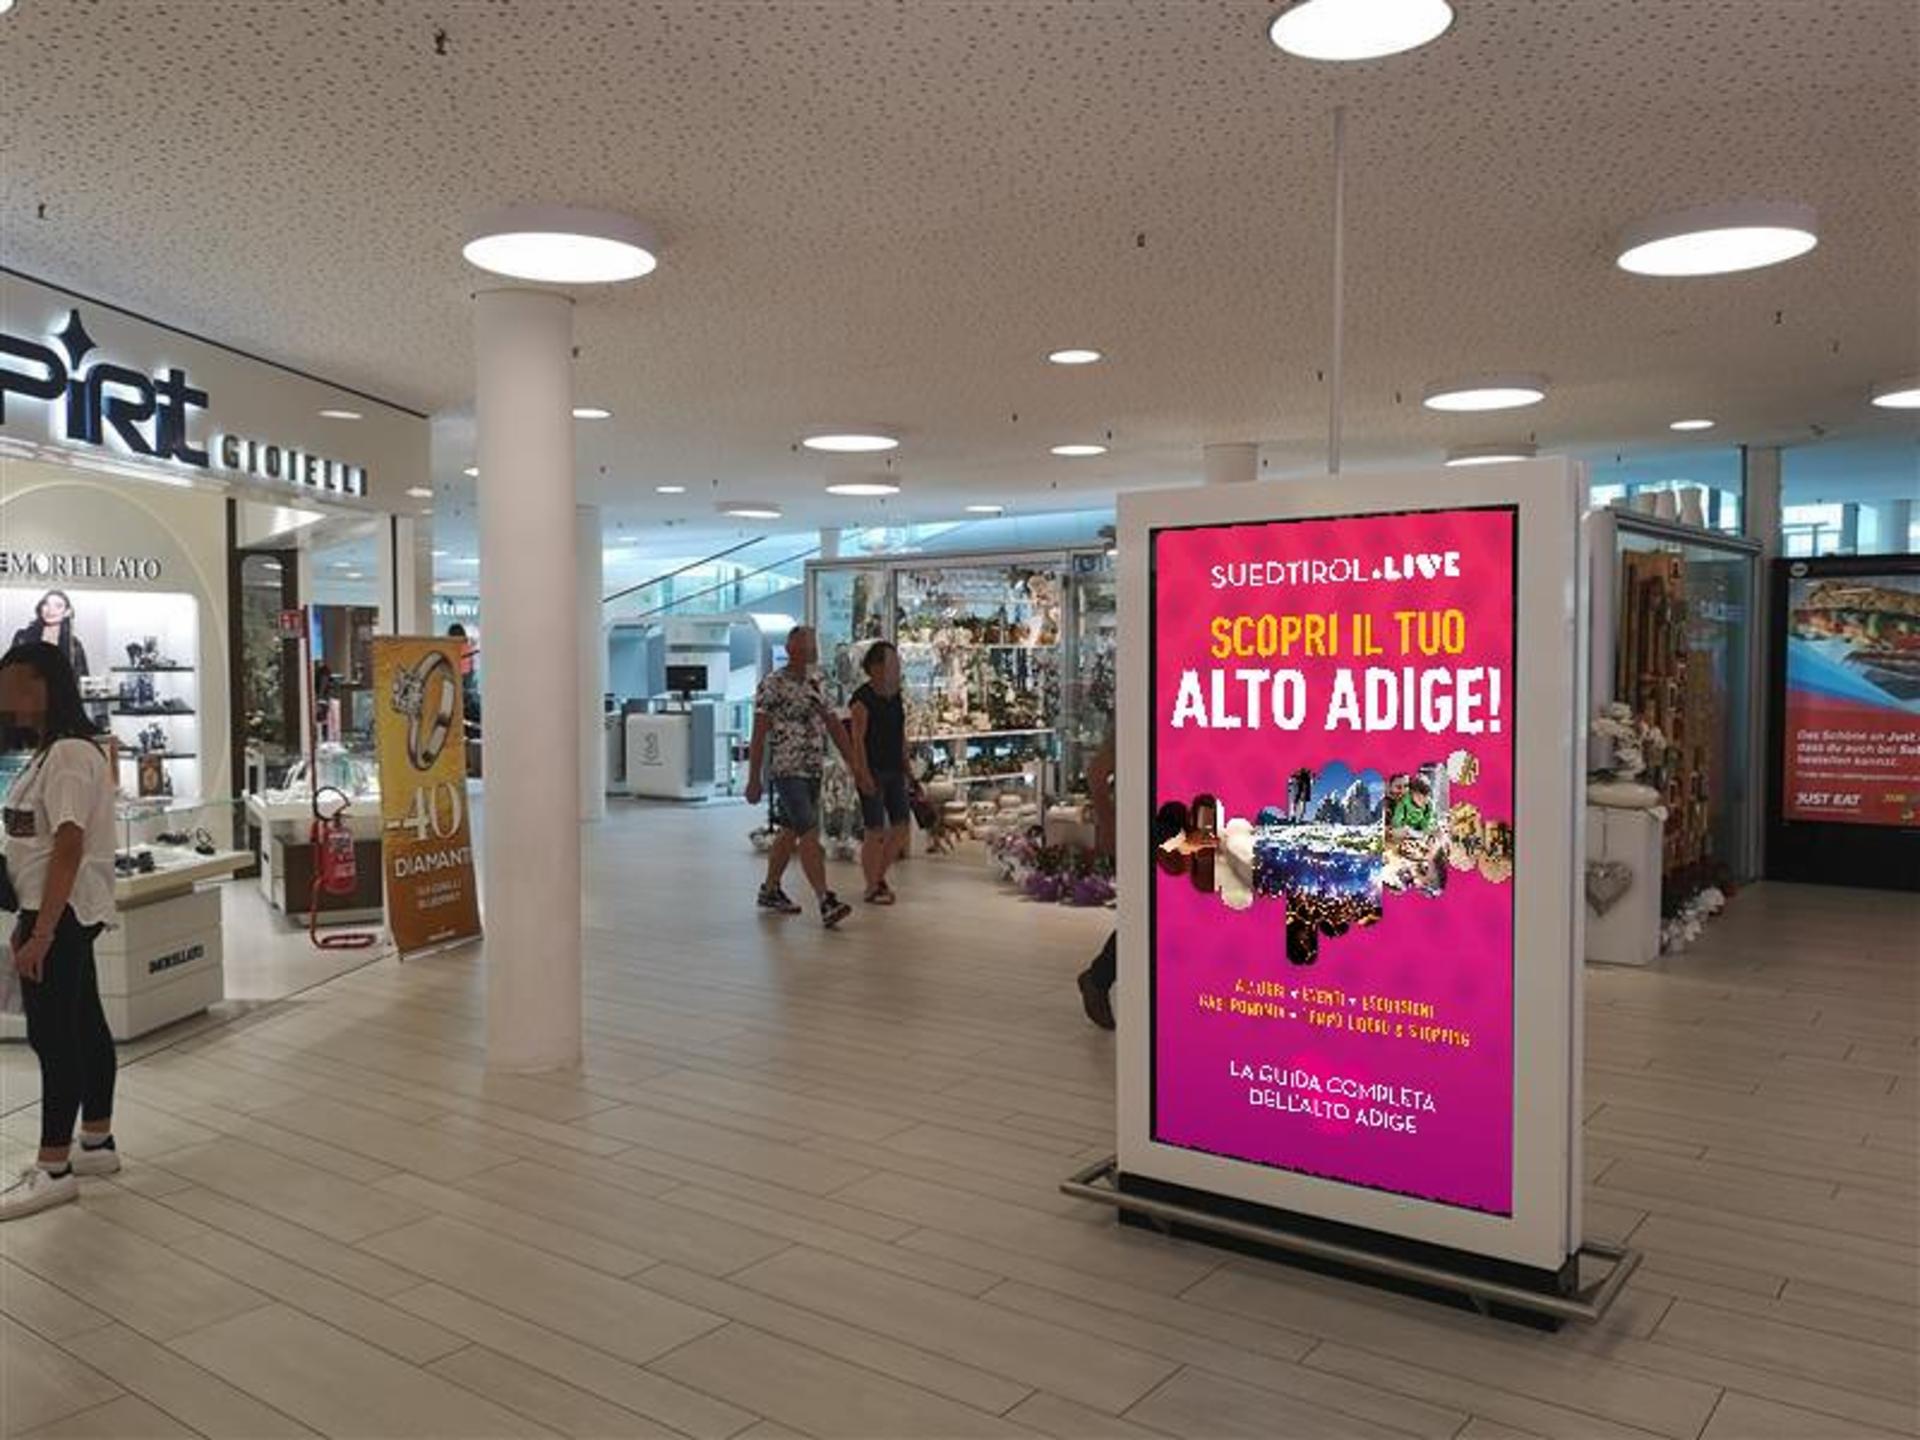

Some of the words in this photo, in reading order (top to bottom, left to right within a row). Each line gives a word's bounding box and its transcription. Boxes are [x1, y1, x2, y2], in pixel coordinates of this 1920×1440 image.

[222, 434, 368, 497] GIOIELLI
[10, 552, 162, 581] MORELLATO
[1210, 611, 1338, 659] SCOPRI
[1353, 613, 1383, 656] IL
[1394, 609, 1465, 656] TUO
[1171, 667, 1306, 731] ALTO
[1324, 666, 1502, 734] ADIGE!
[1796, 792, 1831, 805] JUST
[1832, 793, 1861, 806] EAT
[1230, 1060, 1254, 1080] LA
[1259, 1065, 1322, 1093] GUIDA
[1326, 1077, 1436, 1113] COMPLETA
[1356, 1108, 1417, 1134] ADIGE
